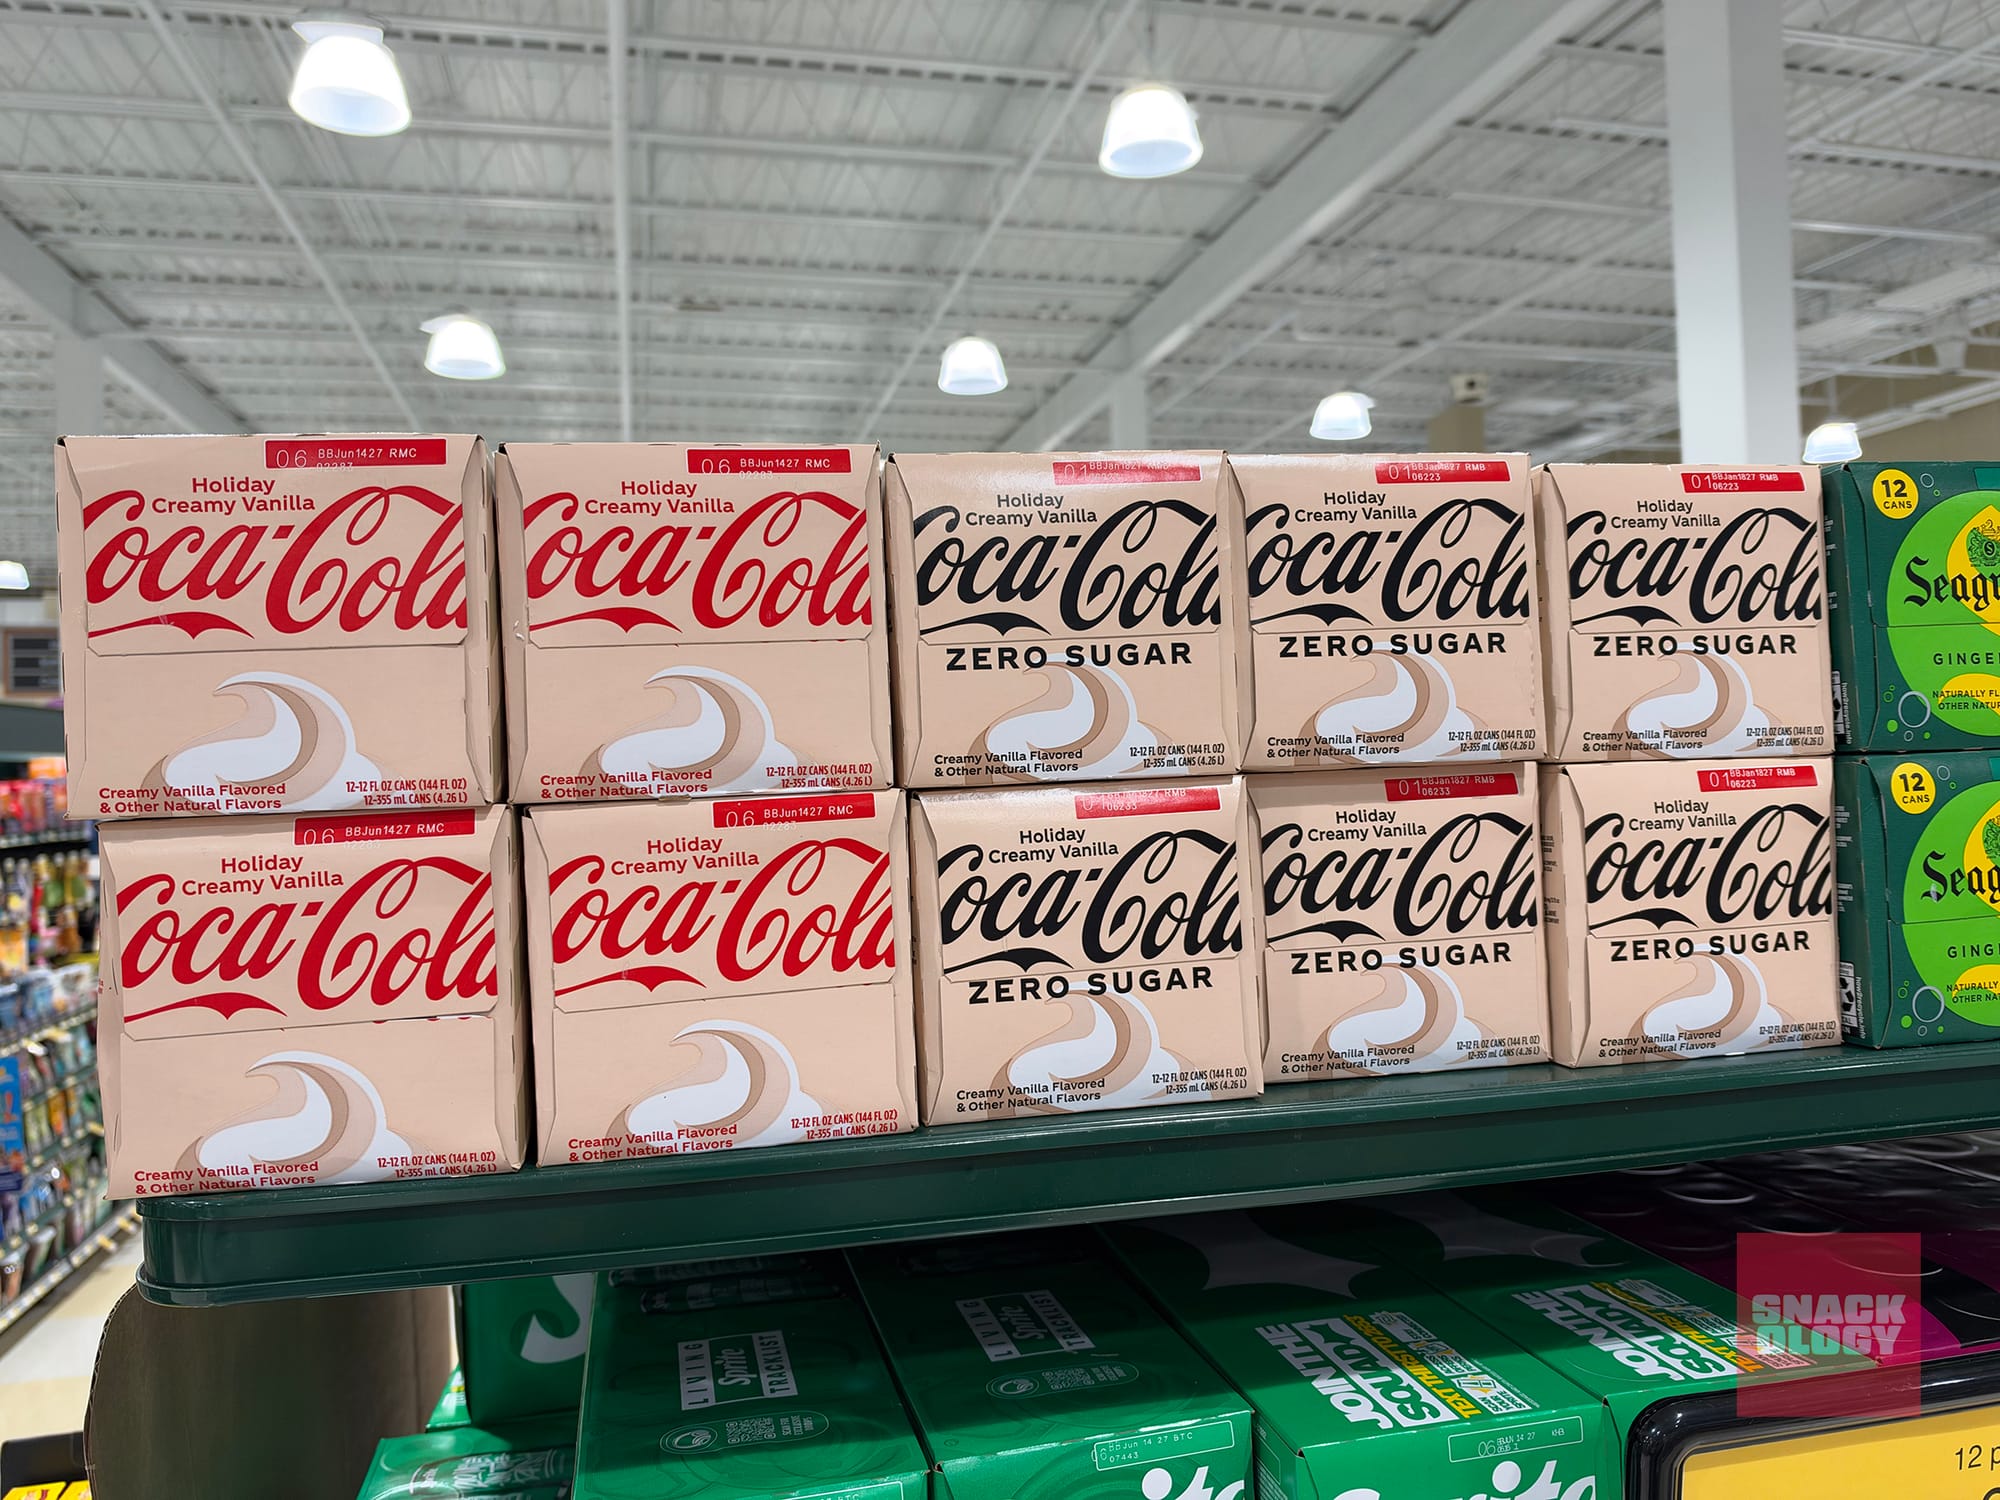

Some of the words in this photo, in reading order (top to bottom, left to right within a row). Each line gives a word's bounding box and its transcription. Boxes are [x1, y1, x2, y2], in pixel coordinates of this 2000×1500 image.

[317, 448, 383, 459] BBJun1427
[389, 448, 416, 458] RMC
[739, 458, 799, 468] BBJun1427
[805, 458, 831, 468] RMC
[1465, 463, 1486, 471] RMB
[192, 477, 274, 495] Holiday
[1712, 482, 1739, 490] 06223
[1759, 473, 1779, 481] RMB
[622, 480, 696, 498] Holiday
[1881, 479, 1908, 498] 12
[152, 498, 236, 515] Creamy
[242, 496, 314, 511] Vanilla
[585, 500, 661, 516] Creamy
[668, 499, 734, 513] Vanilla
[998, 494, 1063, 509] Holiday
[1324, 491, 1385, 506] Holiday
[1637, 500, 1693, 514] Holiday
[1884, 500, 1912, 509] CANS
[966, 513, 1033, 527] Creamy
[1038, 509, 1097, 523] Vanilla
[1295, 510, 1357, 523] Creamy
[1362, 506, 1417, 520] Vanilla
[1611, 517, 1667, 530] Creamy
[1672, 514, 1720, 527] Vanilla
[1280, 635, 1373, 658] ZERO
[1390, 633, 1506, 655] SUGAR
[1594, 636, 1677, 656] ZERO
[1692, 635, 1796, 655] SUGAR
[947, 646, 1051, 671] ZERO
[1065, 643, 1191, 667] SUGAR
[1933, 652, 2000, 665] GINGE
[1932, 690, 1985, 698] NATURALLY
[1938, 701, 1969, 710] OTHER
[935, 755, 982, 765] Creamy
[985, 752, 1026, 762] Vanilla
[1031, 747, 1082, 760] Flavored
[935, 767, 944, 777] &
[946, 766, 982, 779] Other
[985, 764, 1030, 778] Natural
[1035, 763, 1078, 772] Flavors
[1475, 774, 1495, 783] RMB
[1777, 768, 1796, 777] RMB
[1730, 779, 1757, 788] 06223
[1899, 773, 1925, 792] 12
[1655, 800, 1708, 814] Holiday
[1902, 794, 1930, 804] CANS
[764, 807, 824, 819] BBJun1427
[828, 805, 853, 815] RMC
[1336, 809, 1396, 824] Holiday
[345, 824, 411, 837] BBJun1427
[417, 822, 444, 833] RMC
[1629, 819, 1684, 831] Creamy
[1688, 813, 1736, 827] Vanilla
[1020, 828, 1085, 844] Holiday
[1308, 829, 1368, 841] Creamy
[1373, 823, 1426, 837] Vanilla
[648, 837, 722, 854] Holiday
[989, 849, 1055, 863] Creamy
[1060, 842, 1118, 858] Vanilla
[222, 855, 302, 873] Holiday
[611, 860, 687, 875] Creamy
[693, 852, 759, 869] Vanilla
[182, 879, 264, 895] Creamy
[270, 872, 343, 890] Vanilla
[1611, 938, 1693, 961] ZERO
[1709, 931, 1809, 955] SUGAR
[1948, 944, 2000, 958] GING
[1291, 949, 1382, 974] ZERO
[1399, 942, 1511, 968] SUGAR
[969, 976, 1069, 1004] ZERO
[1088, 967, 1212, 995] SUGAR
[1946, 980, 1999, 992] NATURALLY
[1952, 994, 1982, 1004] OTHER
[791, 1118, 810, 1128] 12-12
[811, 1117, 820, 1127] FL
[822, 1115, 832, 1126] OZ
[834, 1113, 854, 1125] CANS
[855, 1112, 872, 1124] (144
[874, 1111, 883, 1121] FL
[885, 1109, 898, 1121] OZ)
[568, 1138, 621, 1148] Creamy
[626, 1133, 672, 1143] Vanilla
[678, 1125, 736, 1138] Flavored
[807, 1128, 829, 1140] 12-355
[831, 1127, 844, 1137] mL
[845, 1125, 866, 1136] CANS
[867, 1123, 887, 1135] (4.26
[570, 1152, 578, 1161] &
[583, 1150, 622, 1160] Other
[626, 1145, 680, 1157] Natural
[683, 1140, 731, 1150] Flavors
[1512, 1291, 1593, 1329] THE
[963, 1301, 1013, 1358] LIVING
[1030, 1294, 1085, 1347] TRACKLIST
[1254, 1323, 1326, 1370] THE
[1598, 1305, 1726, 1374] SQUAD
[758, 1335, 790, 1393] TRACKLIST
[1574, 1329, 1685, 1381] JOIN
[684, 1343, 709, 1405] LIVING
[714, 1348, 758, 1386] Sprite
[1388, 1347, 1446, 1387] THIRST
[1332, 1342, 1440, 1423] SQUAD
[1301, 1366, 1394, 1430] JOIN
[1426, 1384, 1483, 1418] TEXT
[1173, 1432, 1193, 1442] BTC
[1955, 1444, 1982, 1470] 12
